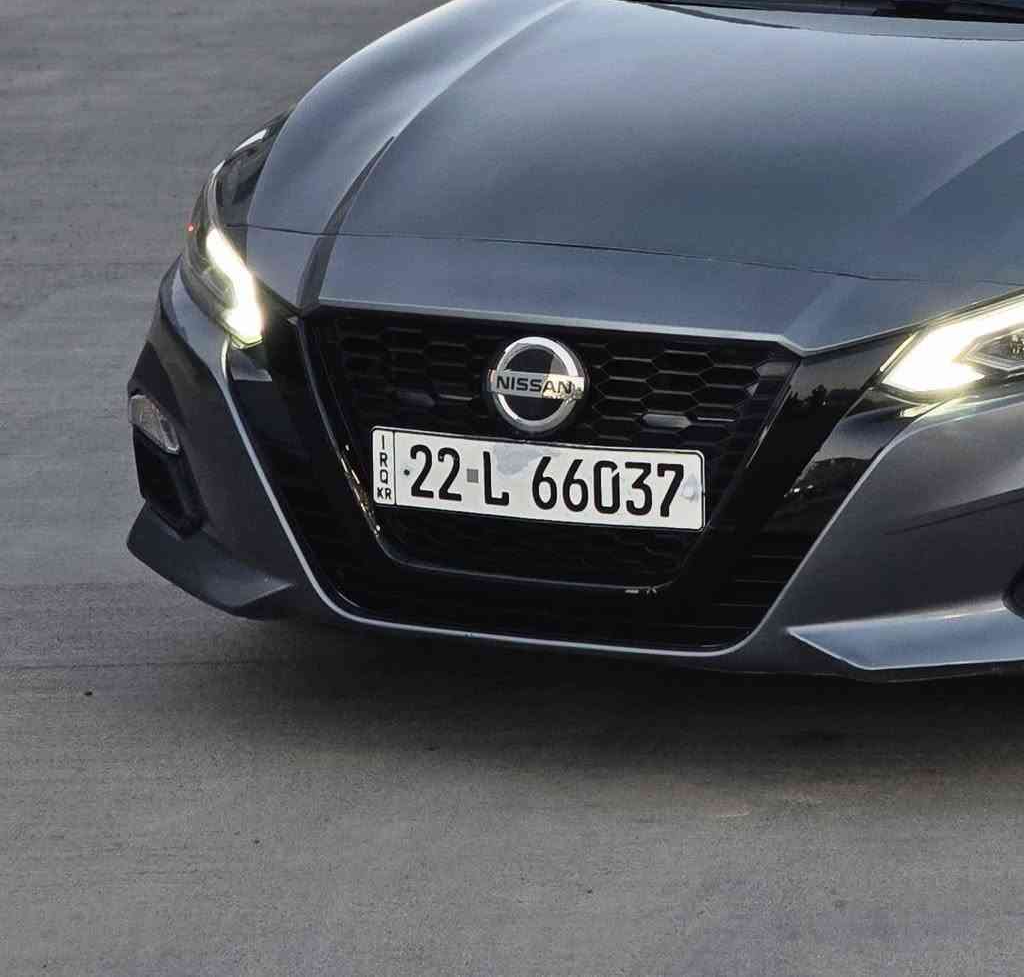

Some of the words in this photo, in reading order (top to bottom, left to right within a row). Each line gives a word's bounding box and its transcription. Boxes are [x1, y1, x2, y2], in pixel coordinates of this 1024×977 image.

[496, 374, 573, 396] NISSAN
[410, 444, 462, 501] 22
[483, 451, 510, 506] L
[532, 456, 684, 517] 66037
[377, 487, 391, 499] KR
